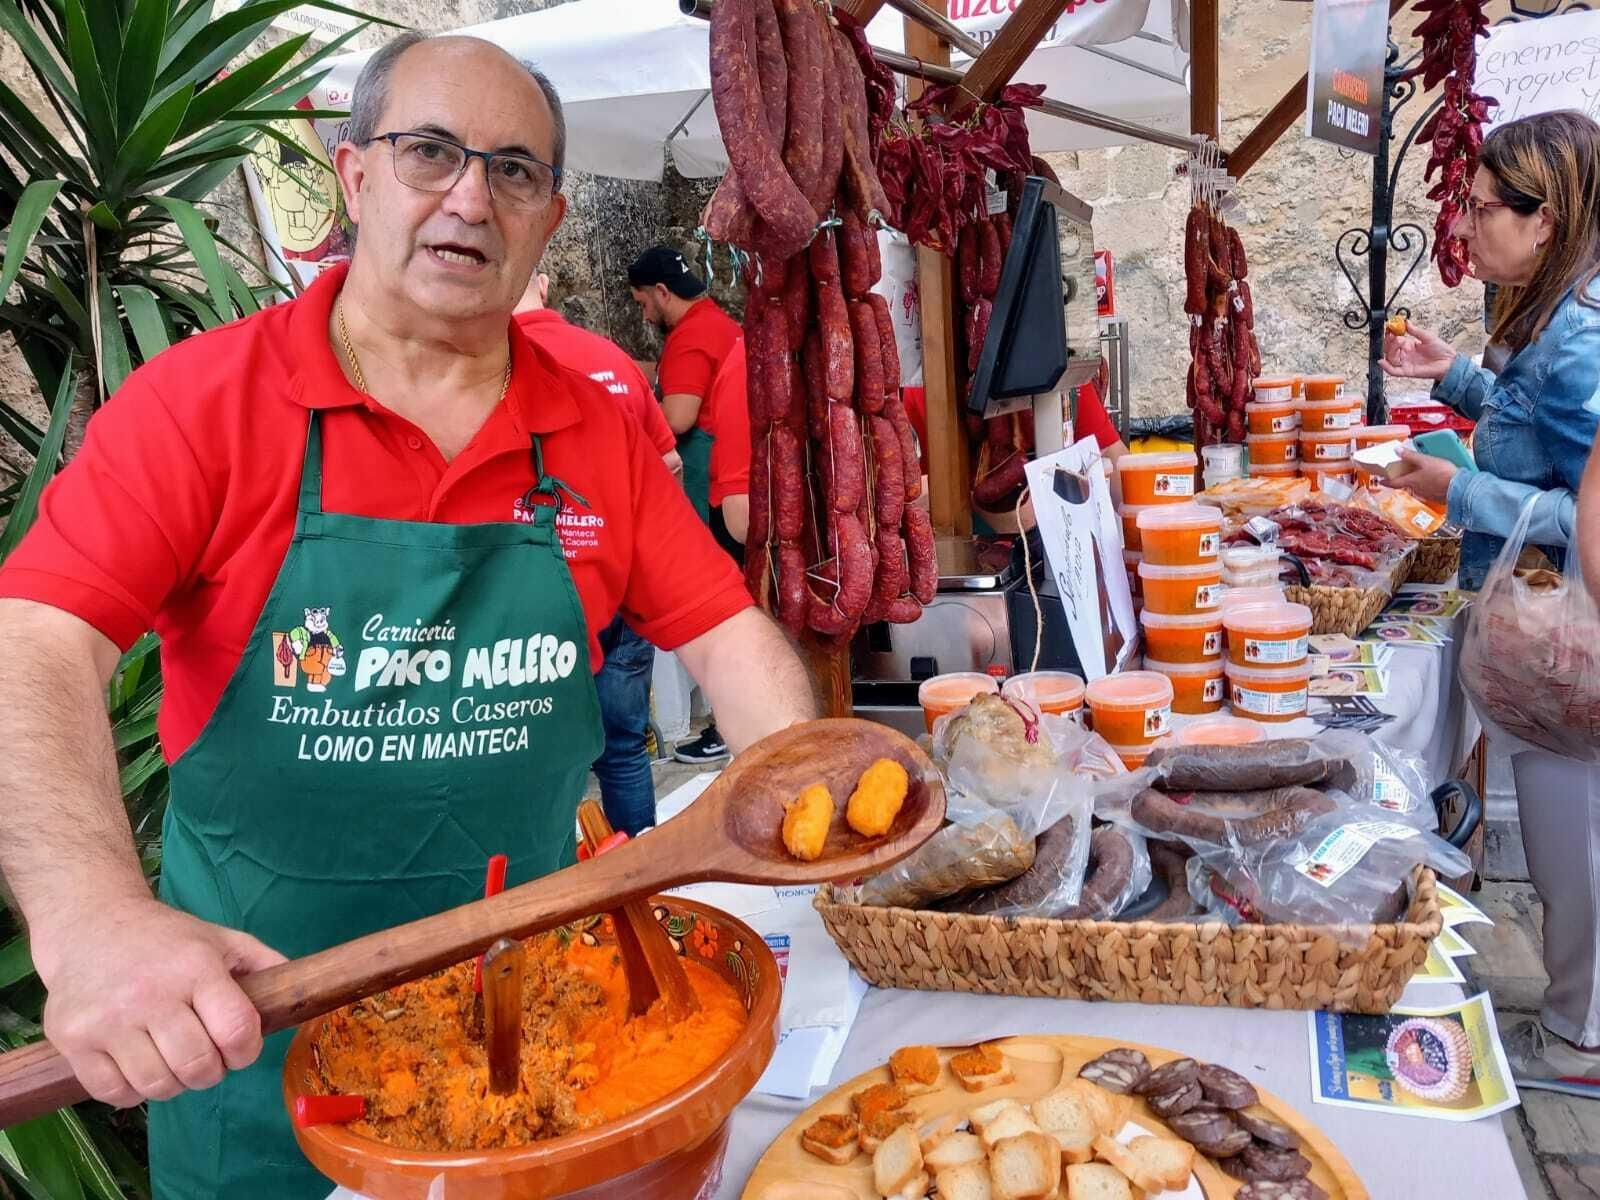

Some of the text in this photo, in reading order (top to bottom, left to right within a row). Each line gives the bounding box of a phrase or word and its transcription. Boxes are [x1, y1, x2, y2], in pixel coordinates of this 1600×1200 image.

[1473, 55, 1600, 103] roquet
[1327, 99, 1369, 137] PACO MELERO
[513, 508, 605, 528] PA MELERO
[561, 528, 596, 538] Manteca
[362, 613, 456, 642] Carnicería
[355, 633, 577, 692] PACO MELERO
[267, 695, 553, 728] Embutidos Caseros
[298, 725, 529, 763] LOMO EN MANTECA
[776, 887, 817, 898] PORQU
